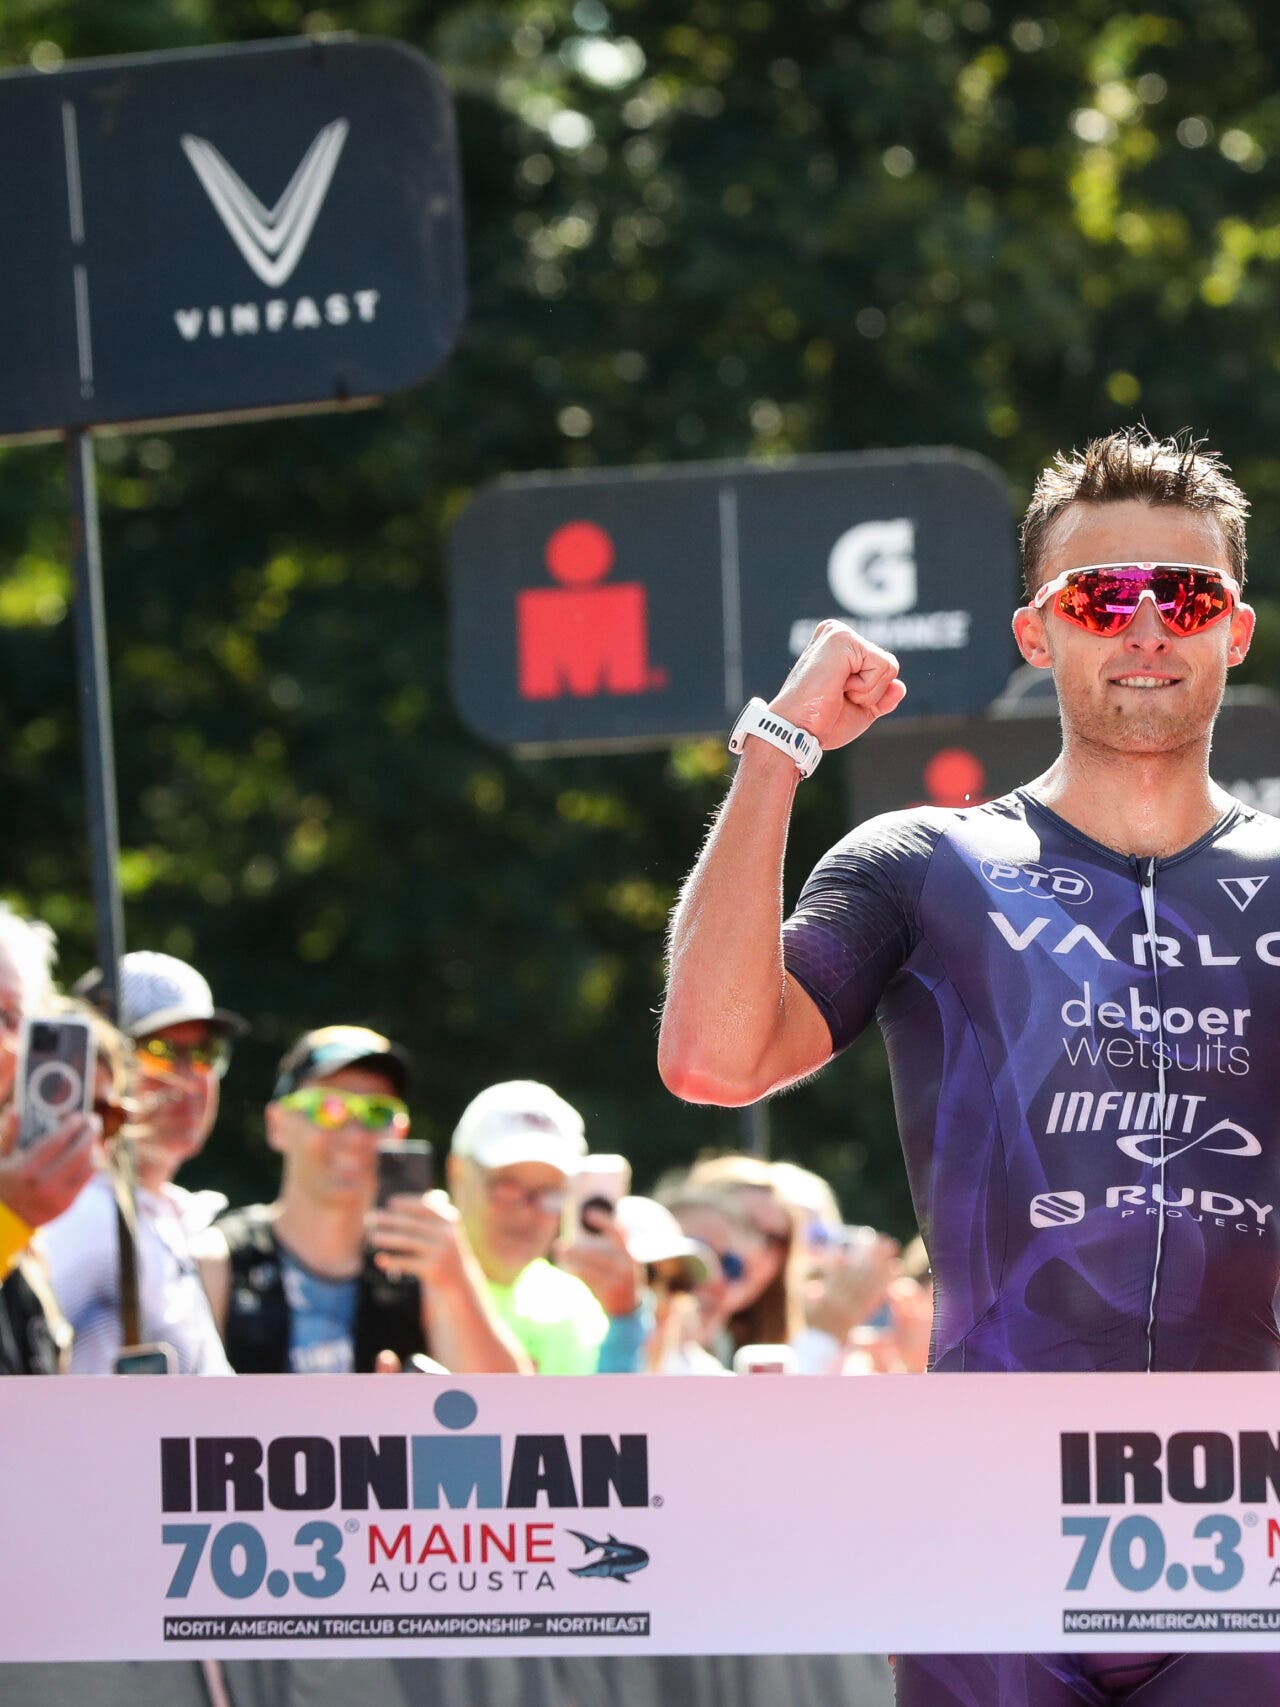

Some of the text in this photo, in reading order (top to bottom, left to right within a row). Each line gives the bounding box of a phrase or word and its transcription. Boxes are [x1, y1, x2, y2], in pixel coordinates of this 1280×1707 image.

[174, 289, 381, 341] VINFAST
[990, 862, 1087, 896] PTO
[1060, 980, 1252, 1036] deboer
[1062, 1032, 1251, 1076] wetsuits
[1106, 1183, 1274, 1225] RUDY
[1120, 1207, 1266, 1237] PROJECT
[161, 1434, 650, 1512] IRONMAN
[162, 1520, 557, 1600] 70.3 MAINE
[1061, 1514, 1245, 1592] 70.3
[369, 1570, 557, 1594] AUGUSTA
[165, 1620, 226, 1637] NORTH
[229, 1619, 320, 1636] AMERICAN
[322, 1618, 395, 1635] TRICLUB
[397, 1617, 532, 1635] CHAMPIONSHIP
[546, 1616, 648, 1634] NORTHEAST
[1064, 1614, 1125, 1630] NORTH
[1127, 1614, 1218, 1630] AMERICAN
